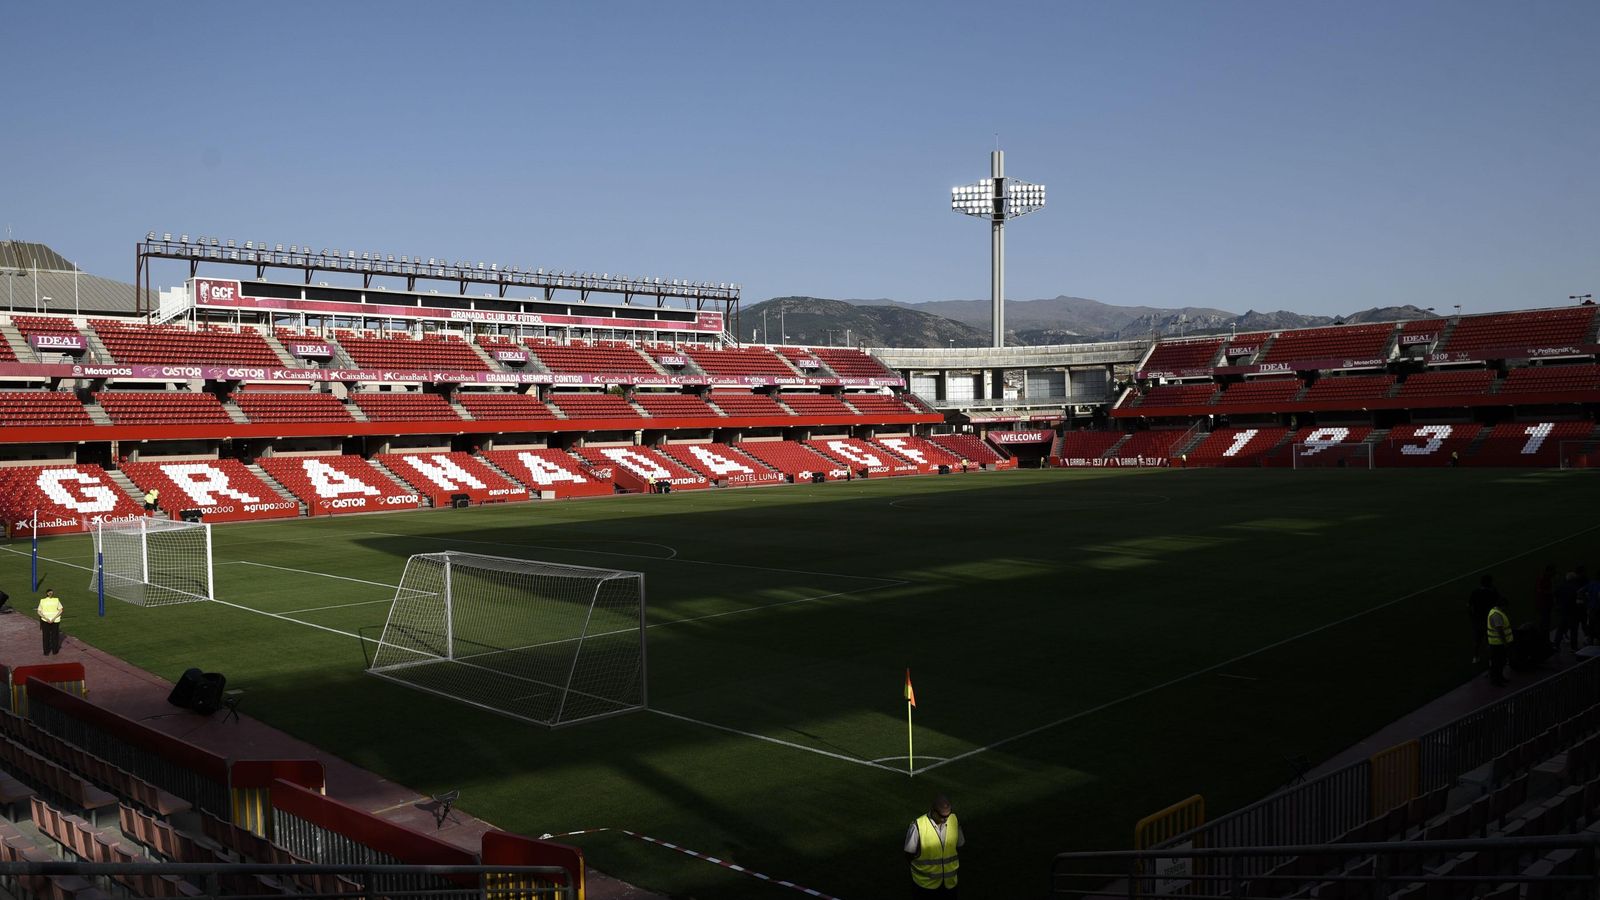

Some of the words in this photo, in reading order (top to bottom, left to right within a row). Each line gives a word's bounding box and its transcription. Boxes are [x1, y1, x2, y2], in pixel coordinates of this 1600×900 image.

[211, 286, 234, 299] GCF
[451, 310, 485, 320] GRANADA
[486, 312, 505, 321] CLUB
[506, 313, 517, 322] DE
[37, 335, 81, 346] IDEAL
[1403, 334, 1431, 342] IDEAL
[296, 345, 330, 354] IDEAL
[1229, 346, 1254, 354] IDEAL
[498, 351, 526, 360] IDEAL
[84, 367, 133, 376] MotorDOS
[162, 366, 202, 377] CASTOR
[1259, 362, 1291, 371] IDEAL
[227, 367, 265, 378] CASTOR
[283, 369, 323, 381] CaixaBank
[340, 370, 377, 381] CaixaBank
[393, 370, 429, 382] CaixaBank
[442, 372, 477, 383] CaixaBank
[486, 374, 521, 383] GRANADA
[522, 374, 553, 383] SIEMPRE
[554, 374, 583, 383] CONTIGO
[774, 376, 796, 384] Granada
[1001, 433, 1042, 442] WELCOME
[734, 474, 757, 482] HOTEL
[758, 473, 777, 481] LUNA
[332, 498, 366, 509] CASTOR
[387, 494, 419, 505] CASTOR
[250, 502, 295, 513] grupo2000
[29, 518, 78, 529] CaixaBank
